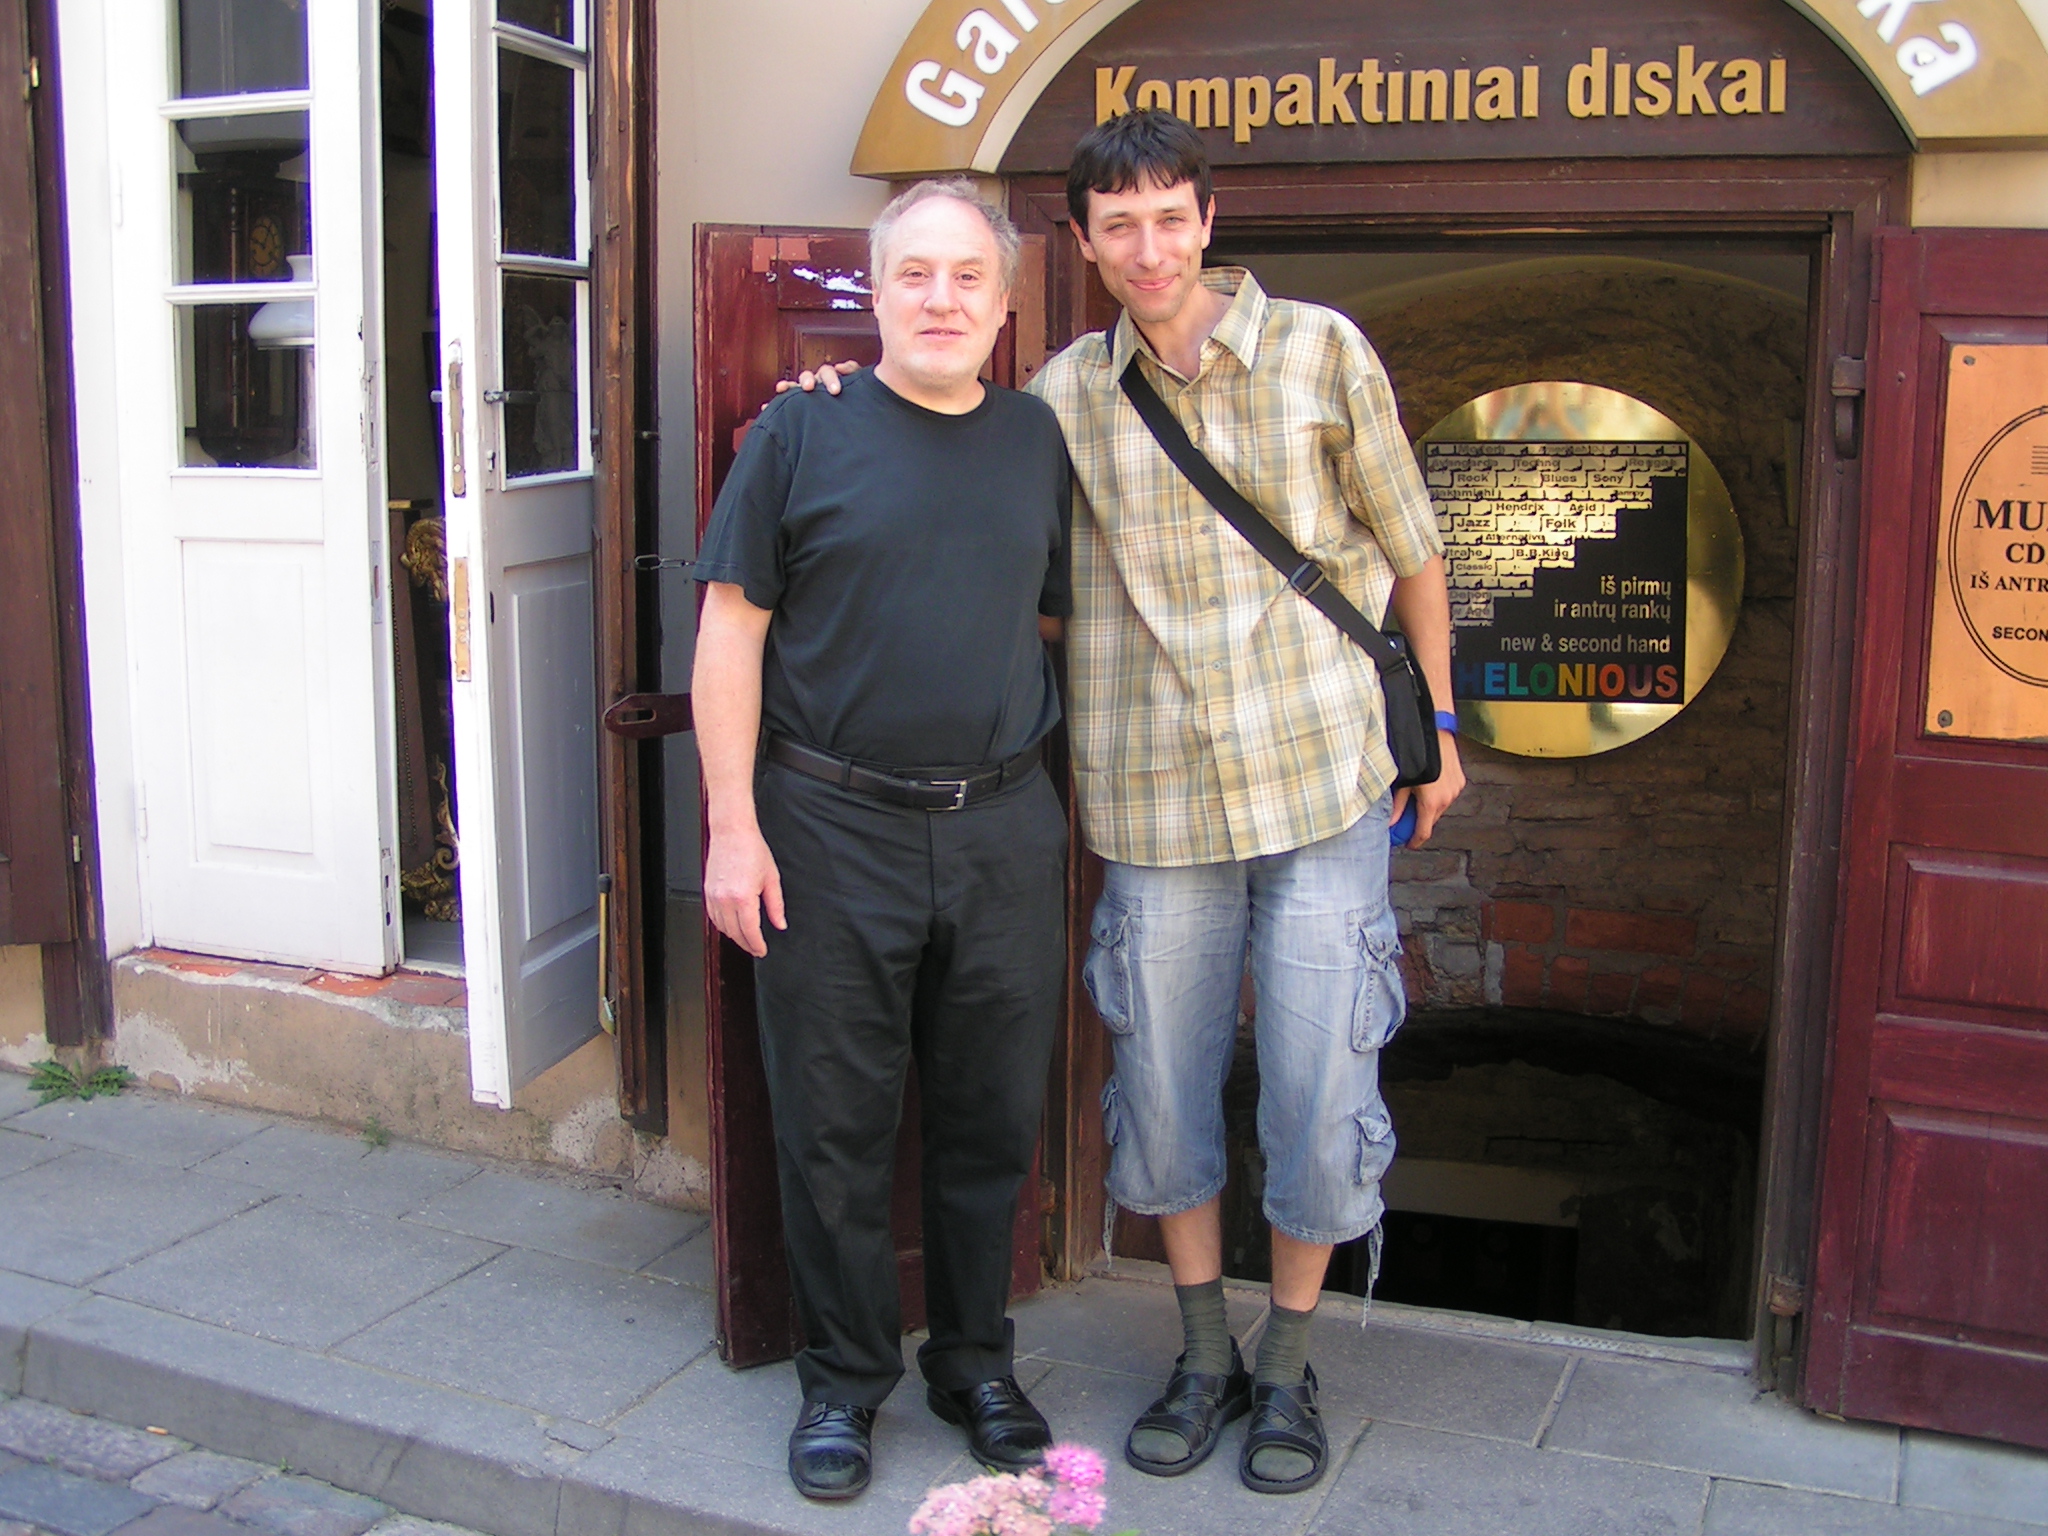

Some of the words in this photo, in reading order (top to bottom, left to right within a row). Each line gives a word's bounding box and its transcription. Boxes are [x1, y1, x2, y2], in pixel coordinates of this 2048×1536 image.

[1457, 474, 1489, 483] Rock
[1543, 474, 1577, 483] Blues
[1593, 474, 1624, 484] Sony
[1495, 502, 1545, 512] Hendrix
[1569, 502, 1597, 512] Acid
[1973, 498, 2048, 531] MU
[1457, 518, 1491, 528] Jazz
[1545, 518, 1577, 529] Folk
[2006, 541, 2047, 564] CD
[1456, 563, 1493, 571] Classic
[1969, 570, 1990, 590] IŠ
[1601, 577, 1616, 596] iš
[1621, 577, 1672, 600] pirmų
[1554, 600, 1567, 619] ir
[1570, 602, 1617, 624] antrų
[1621, 601, 1672, 625] rankų
[1501, 637, 1536, 652] new
[1540, 633, 1553, 653] &
[1558, 634, 1622, 653] second
[1627, 635, 1671, 654] hand
